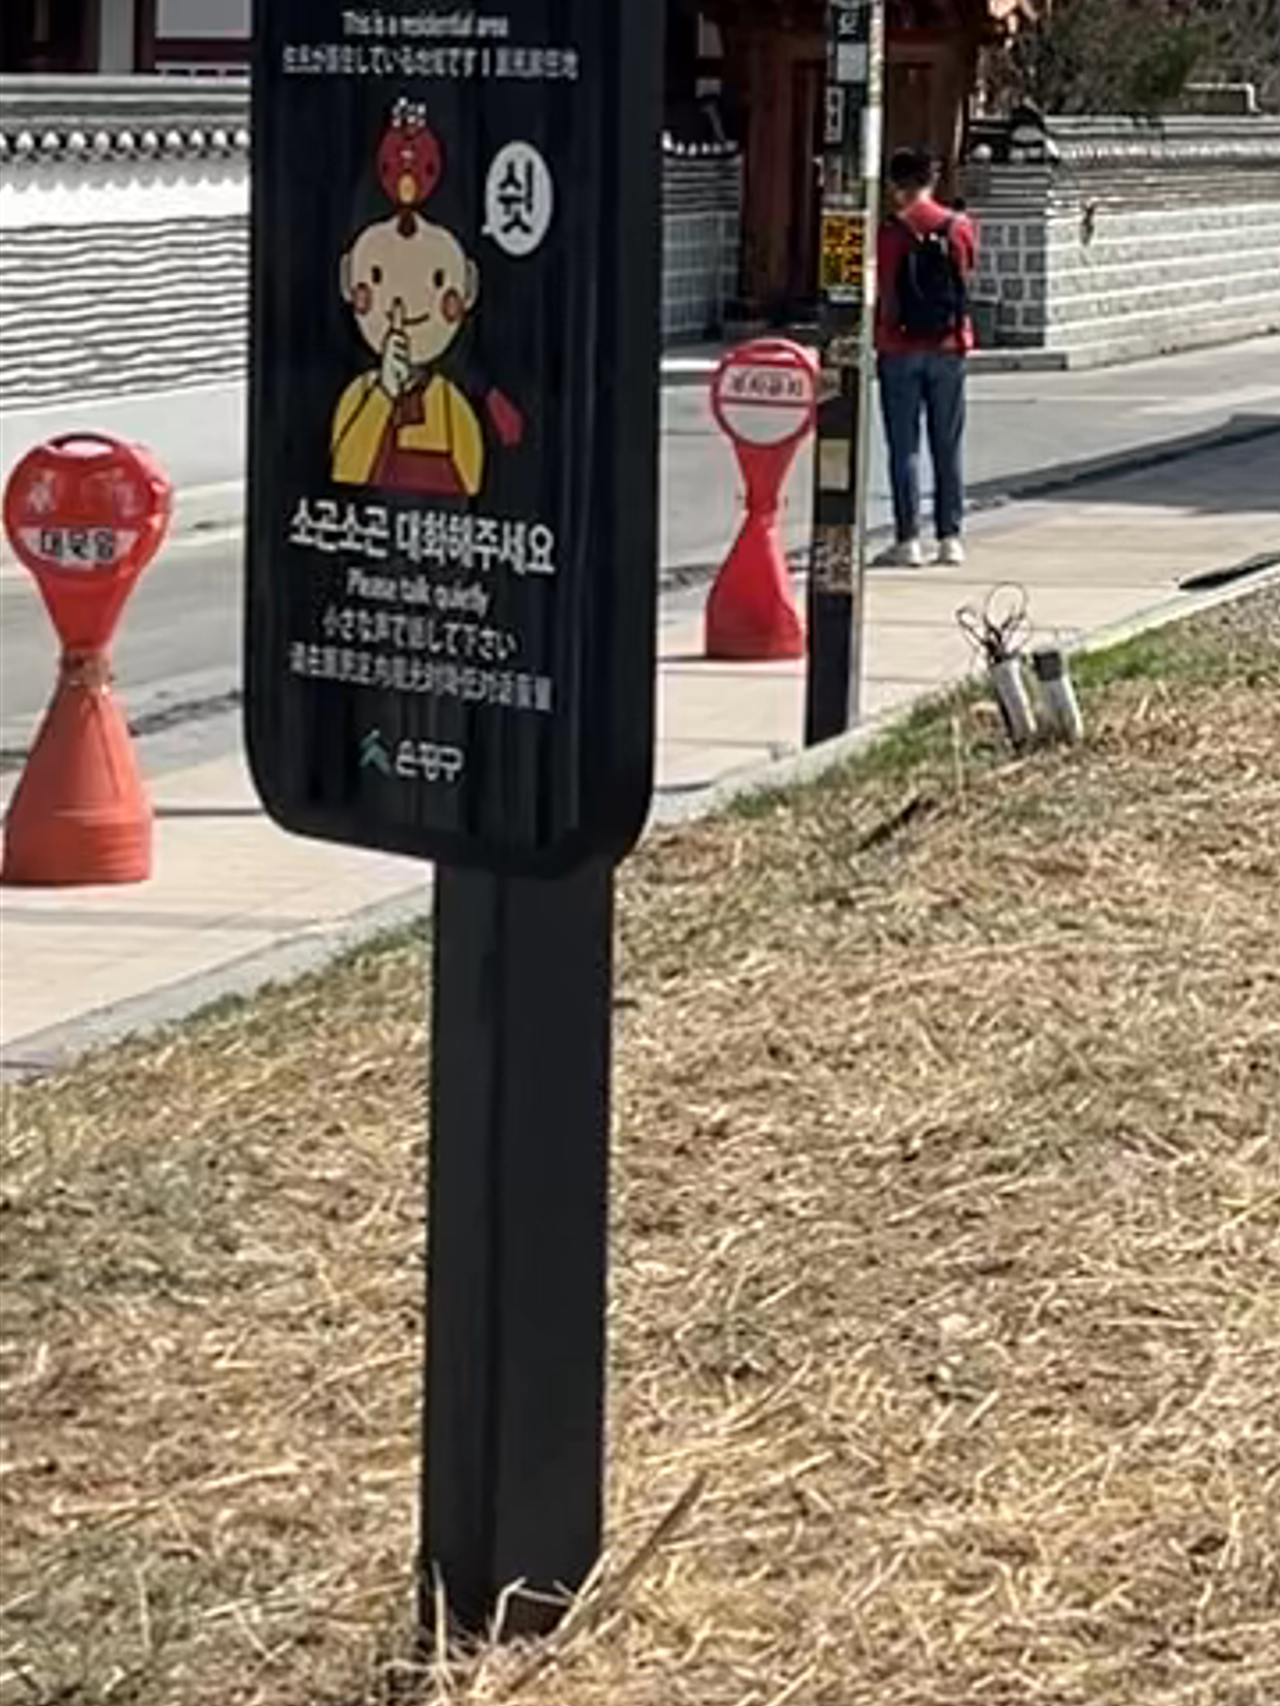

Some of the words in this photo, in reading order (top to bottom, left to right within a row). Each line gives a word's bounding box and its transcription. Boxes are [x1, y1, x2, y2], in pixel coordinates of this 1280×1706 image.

[342, 11, 369, 36] This
[401, 10, 474, 36] residential
[497, 160, 533, 234] 쉿
[288, 498, 389, 558] 소곤소곤
[396, 510, 555, 574] 대화해주세요
[347, 568, 397, 601] Please
[401, 574, 430, 605] talk
[434, 580, 490, 617] quietly
[395, 740, 463, 782] 은평구
